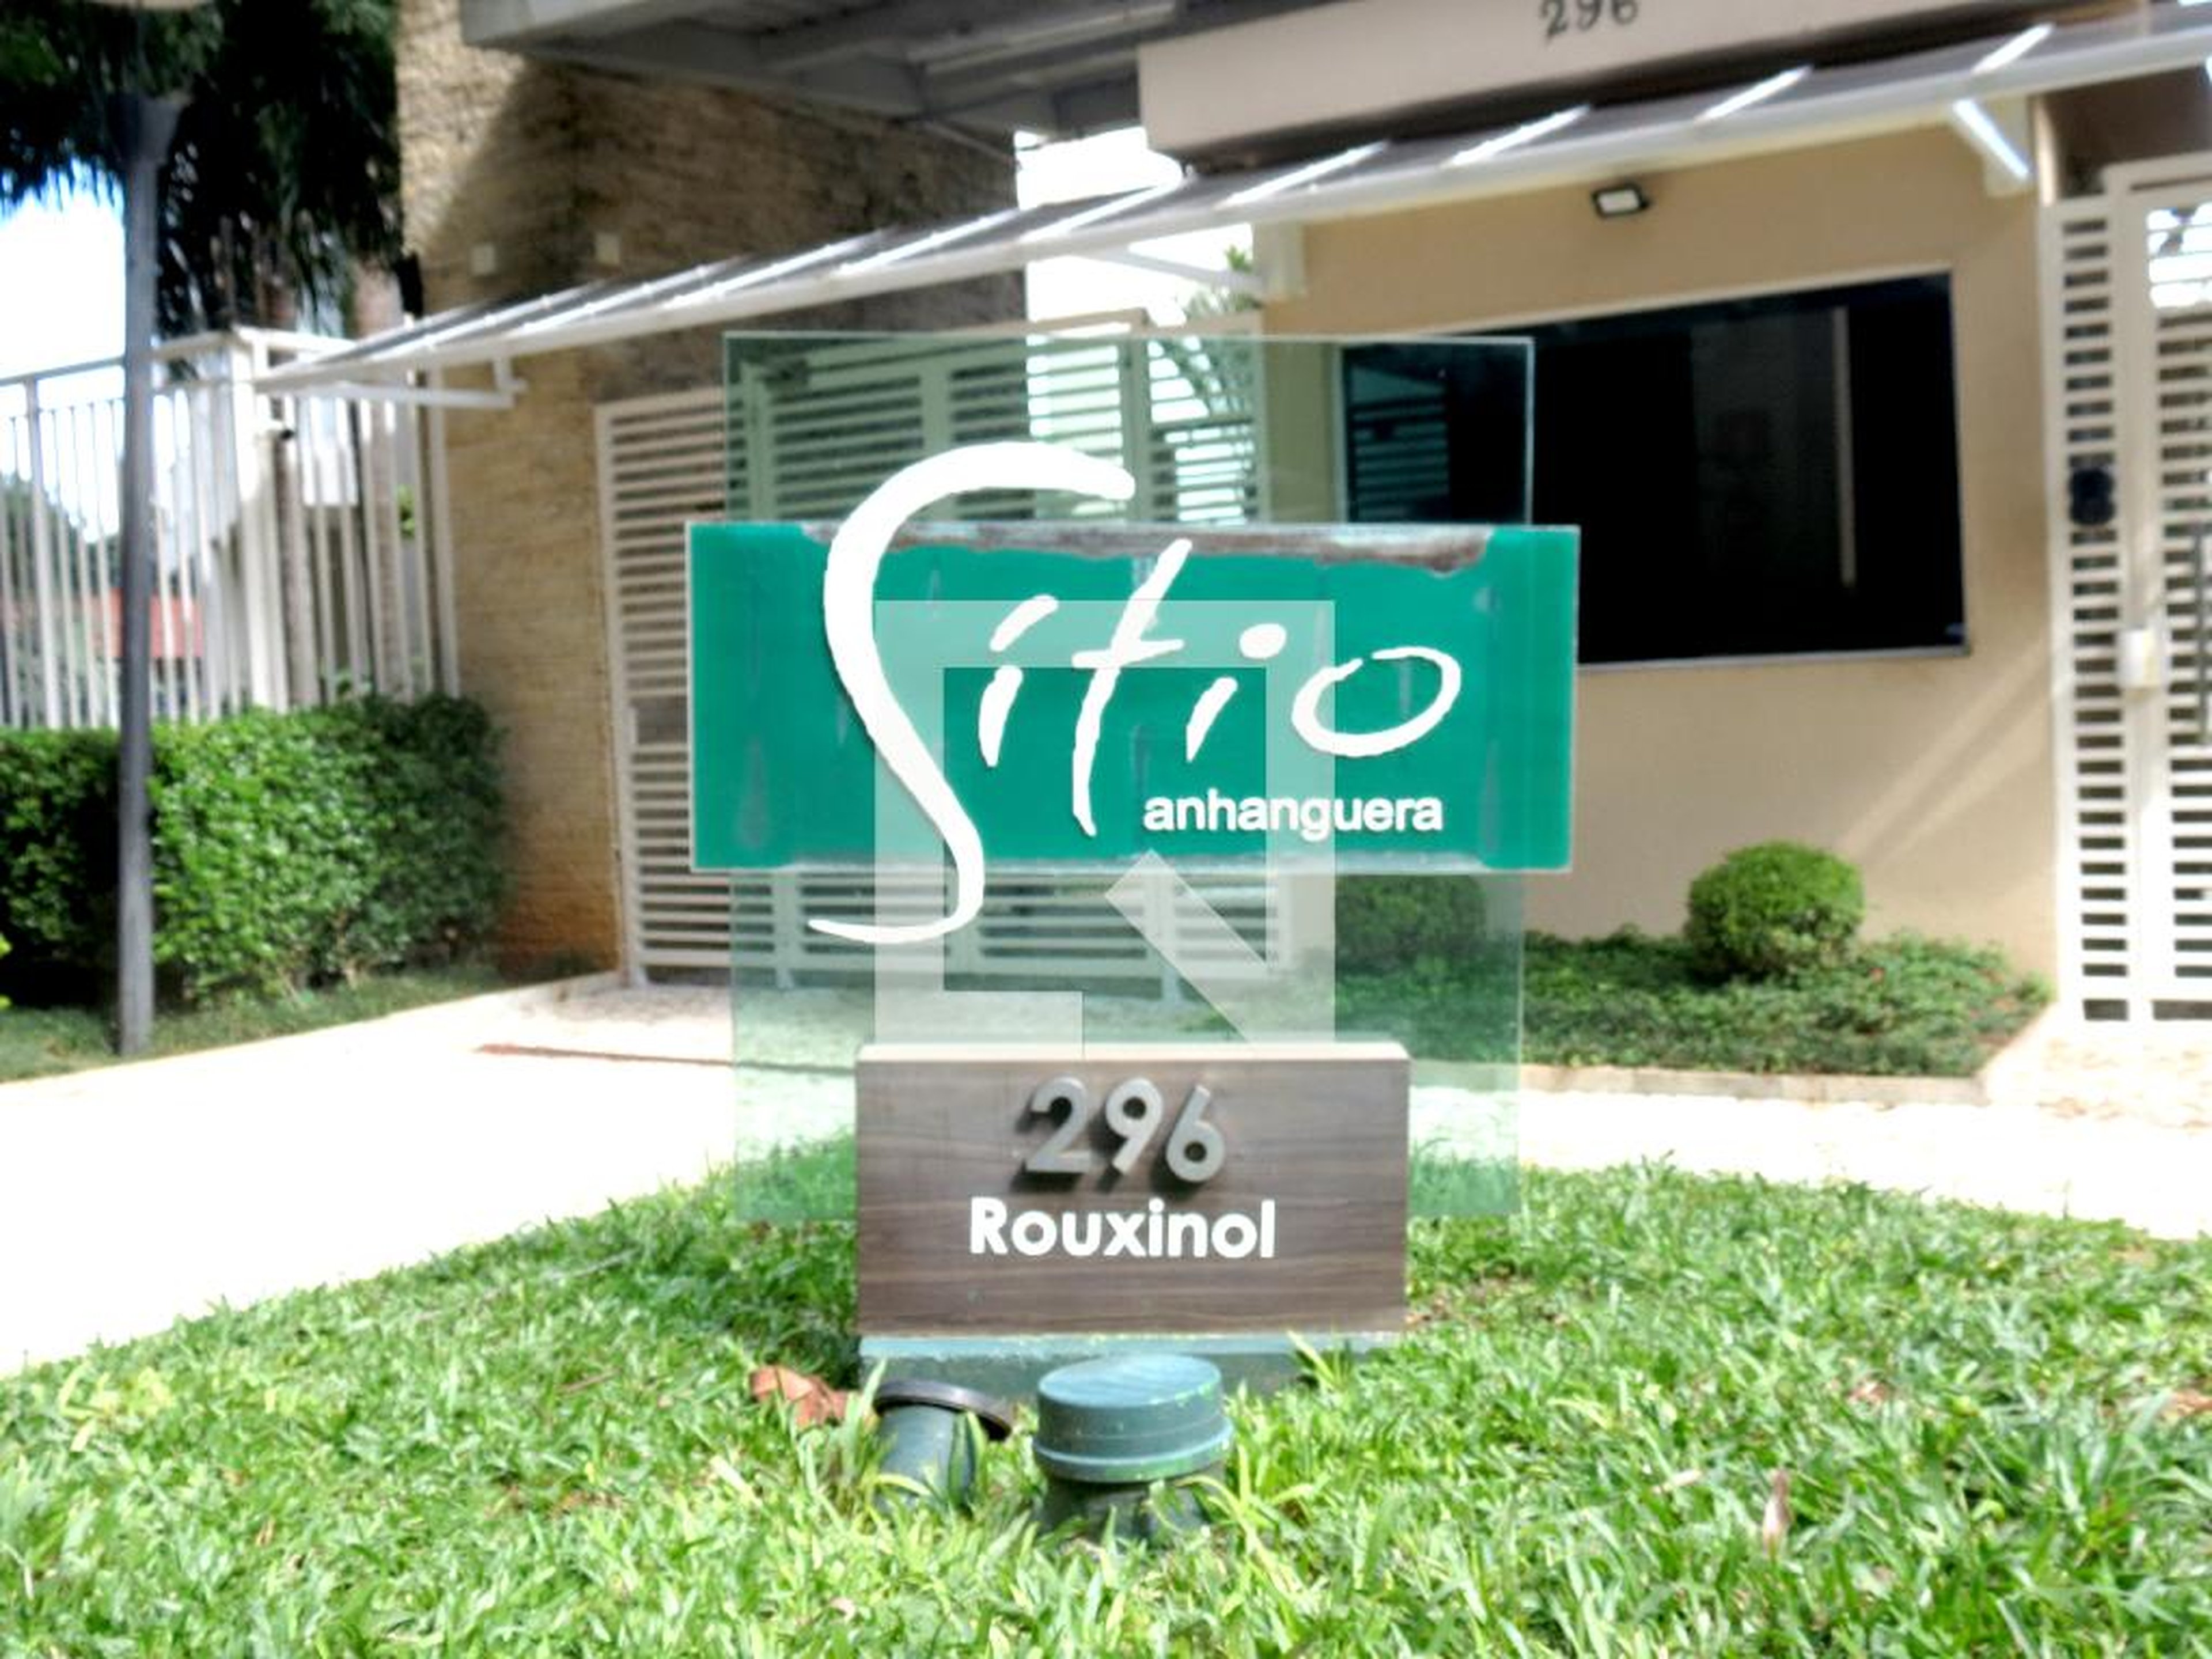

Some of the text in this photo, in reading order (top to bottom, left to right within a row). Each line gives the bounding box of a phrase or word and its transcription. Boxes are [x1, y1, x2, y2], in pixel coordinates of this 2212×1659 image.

[1143, 787, 1444, 842] anhanguera
[1027, 1076, 1226, 1182] 296
[970, 1196, 1275, 1259] Rouxinol
